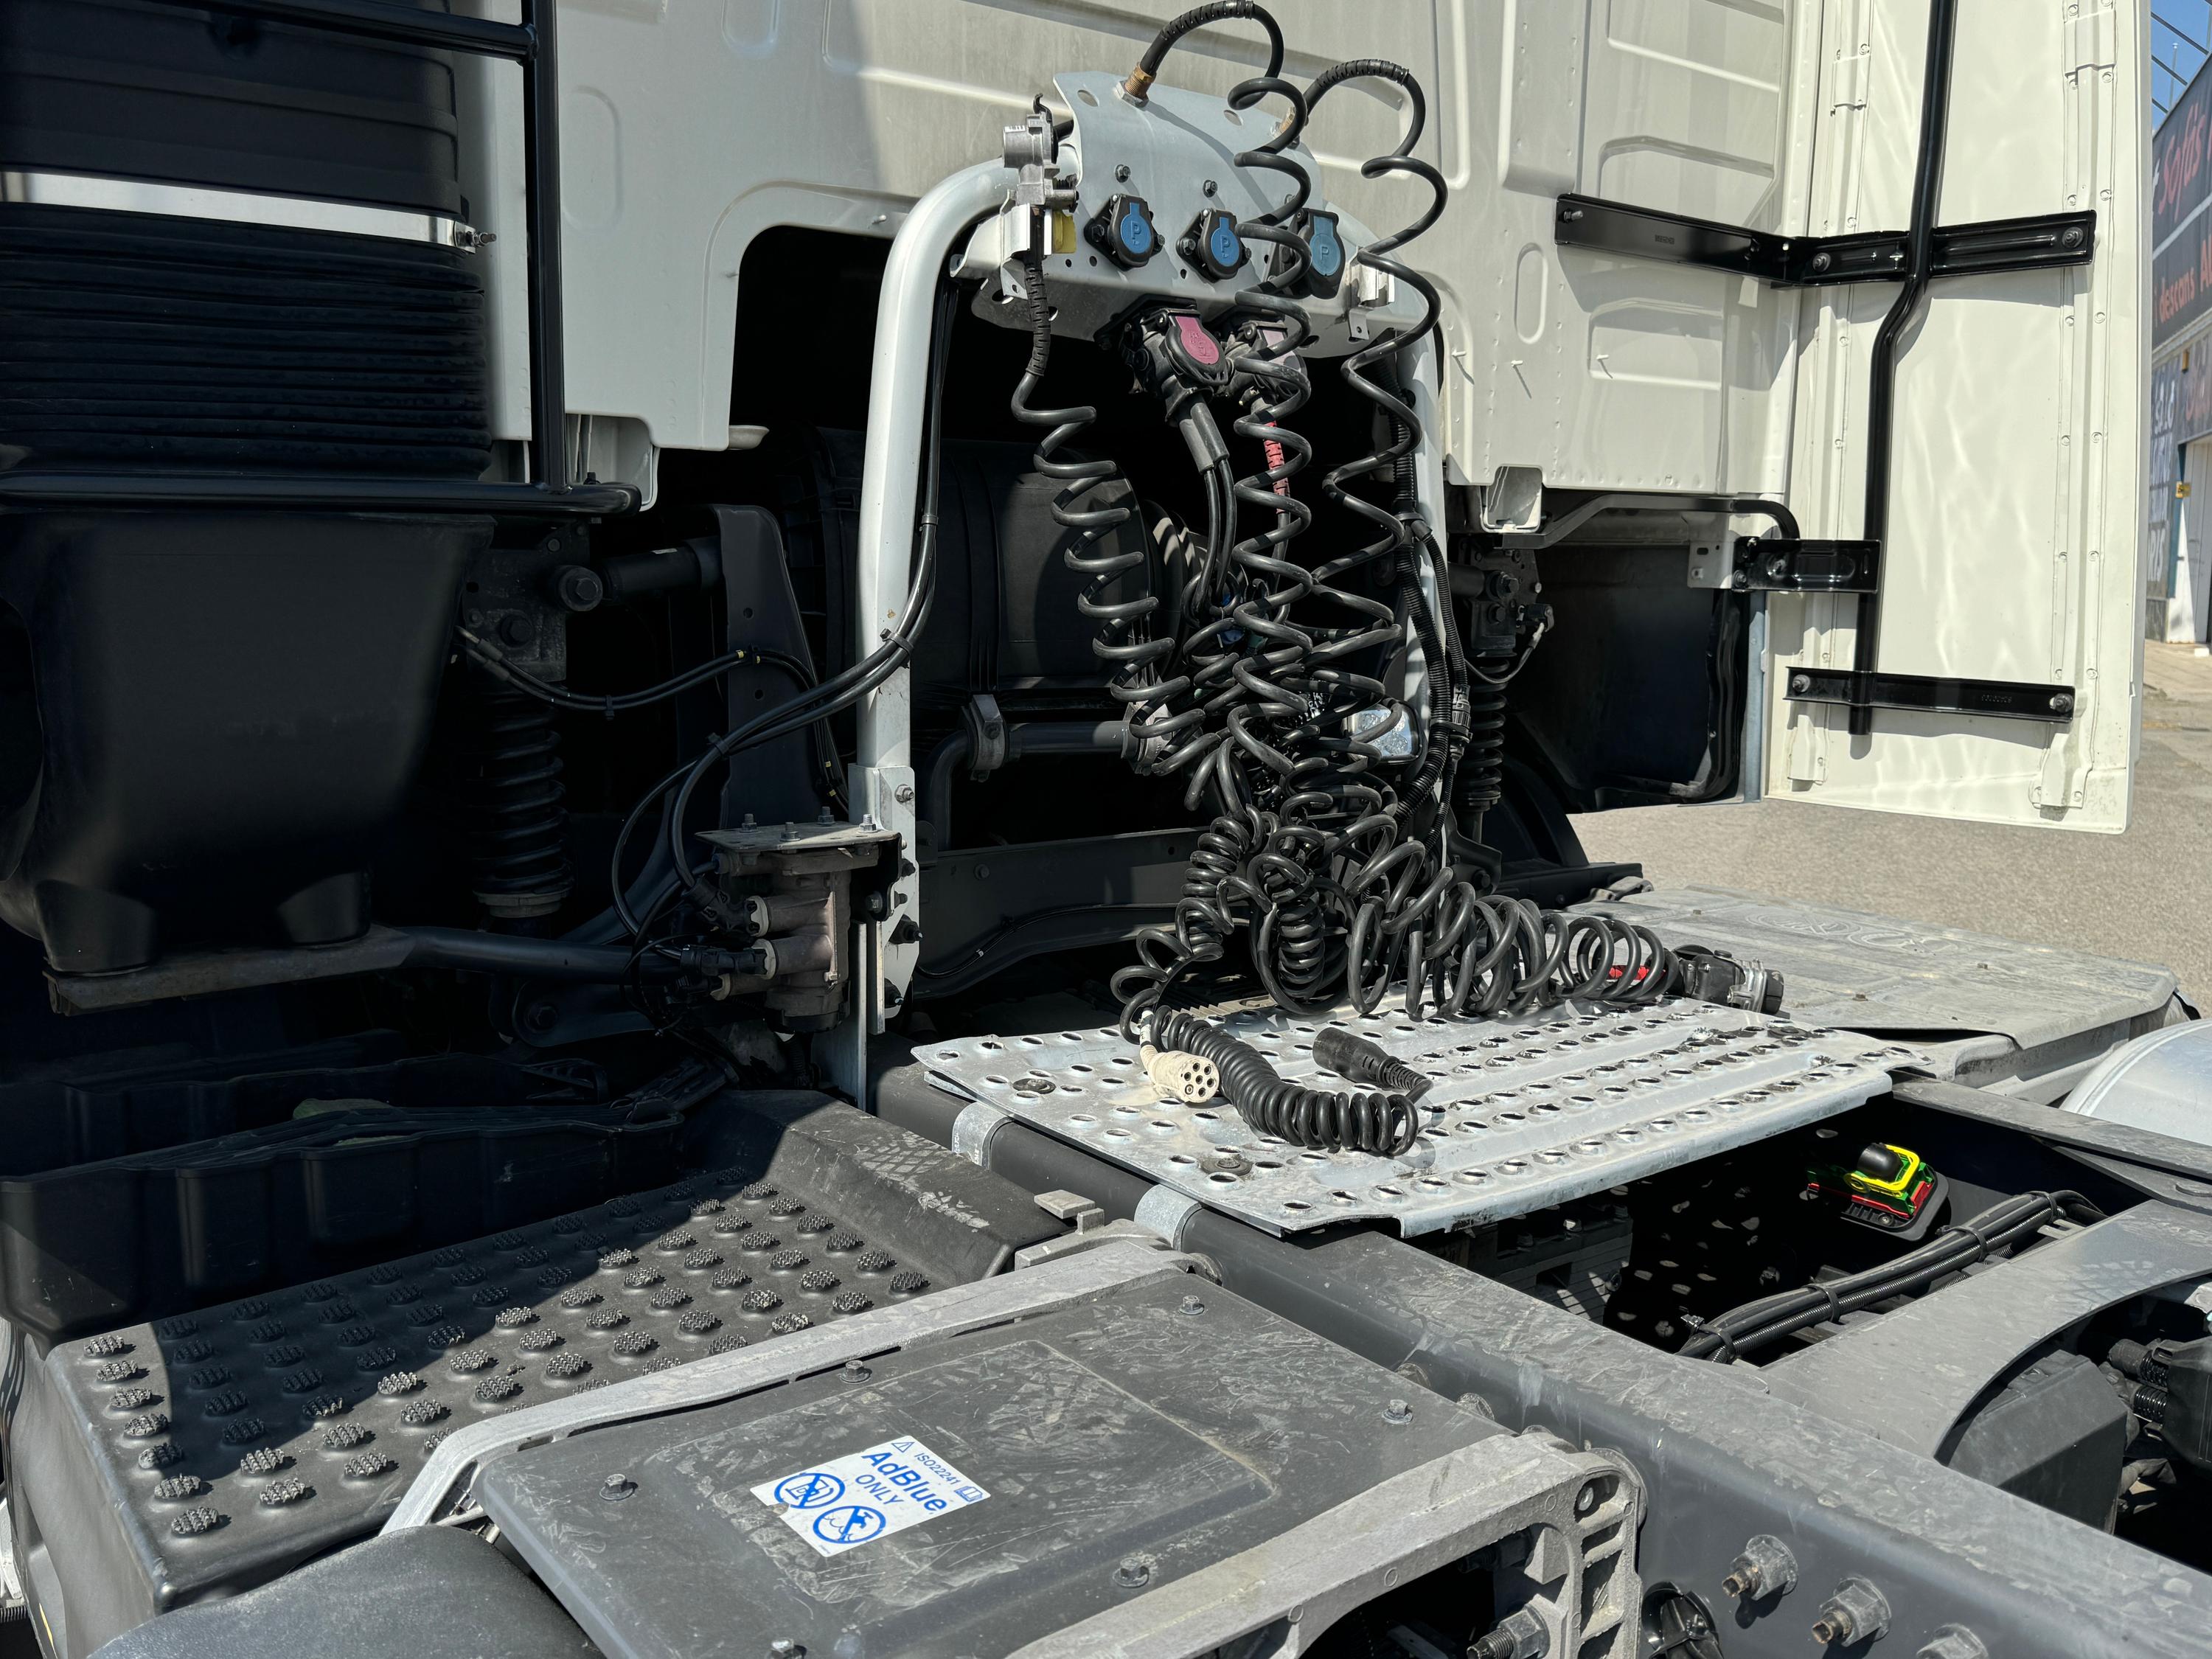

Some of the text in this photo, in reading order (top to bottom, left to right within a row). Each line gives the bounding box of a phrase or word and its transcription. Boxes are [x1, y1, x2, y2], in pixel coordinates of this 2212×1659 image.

[2159, 267, 2195, 324] descans
[855, 1474, 905, 1506] ONLY
[861, 1452, 947, 1512] AdBlue
[914, 1453, 961, 1486] ISO22241
